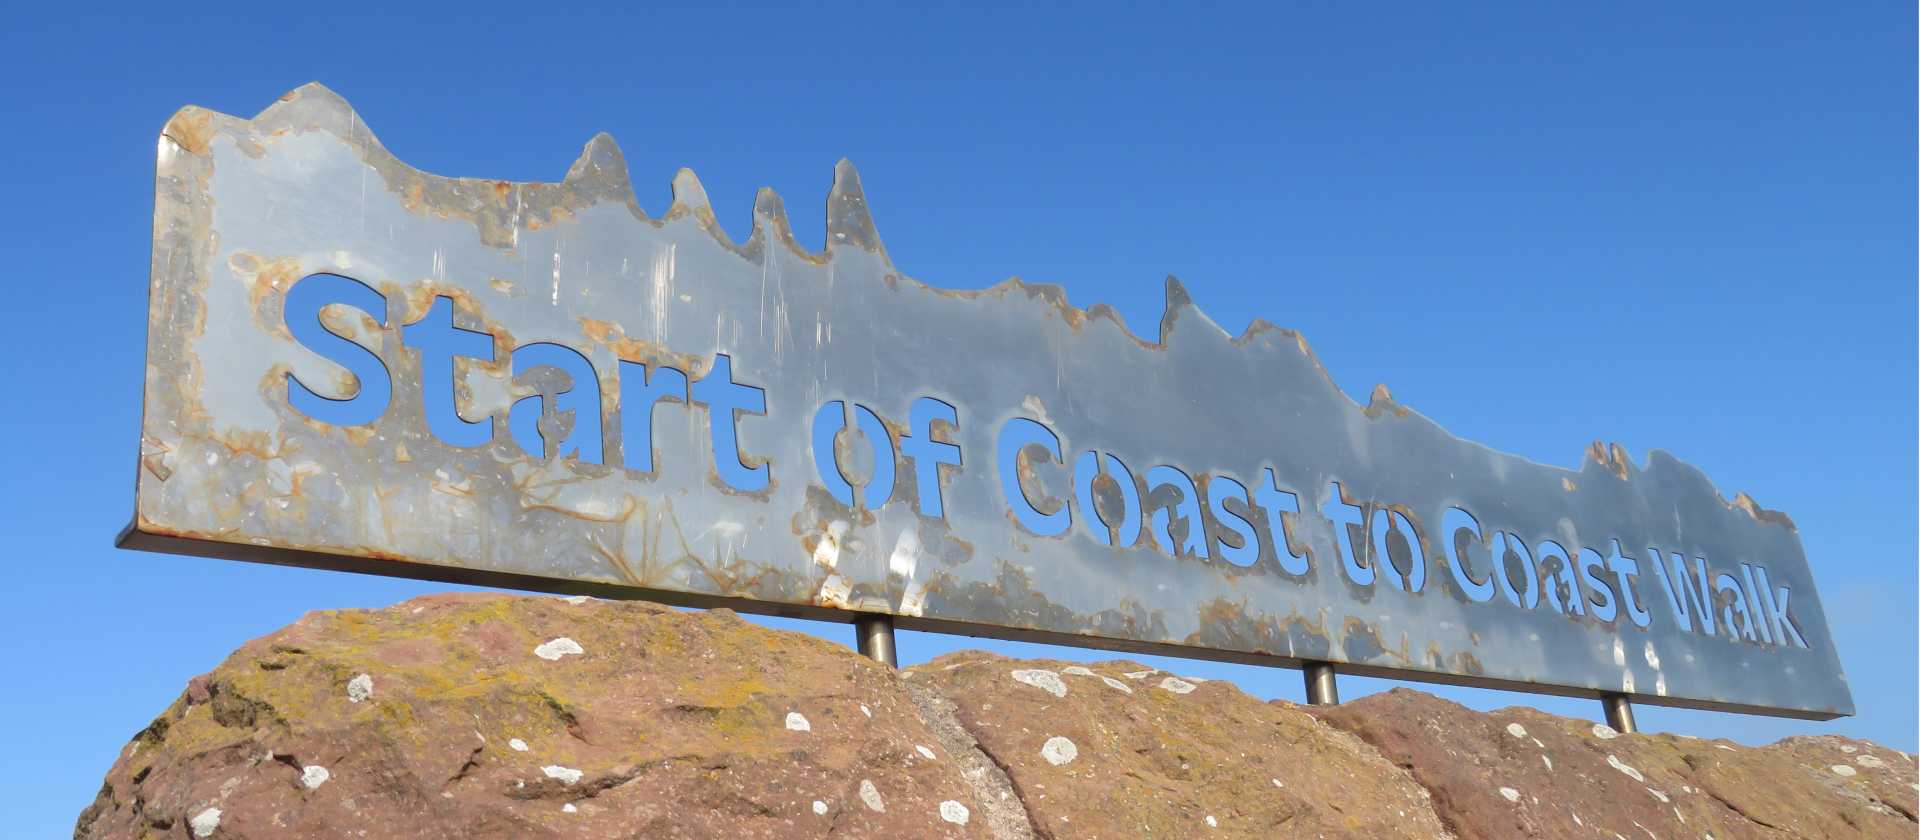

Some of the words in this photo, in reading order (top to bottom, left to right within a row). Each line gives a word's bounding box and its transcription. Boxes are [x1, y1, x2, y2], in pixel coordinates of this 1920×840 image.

[282, 271, 770, 492] Start
[811, 396, 963, 519] of
[996, 416, 1312, 577] Coast
[1321, 481, 1427, 593] to
[1441, 506, 1653, 629] Coast
[1646, 546, 1811, 649] Walk
